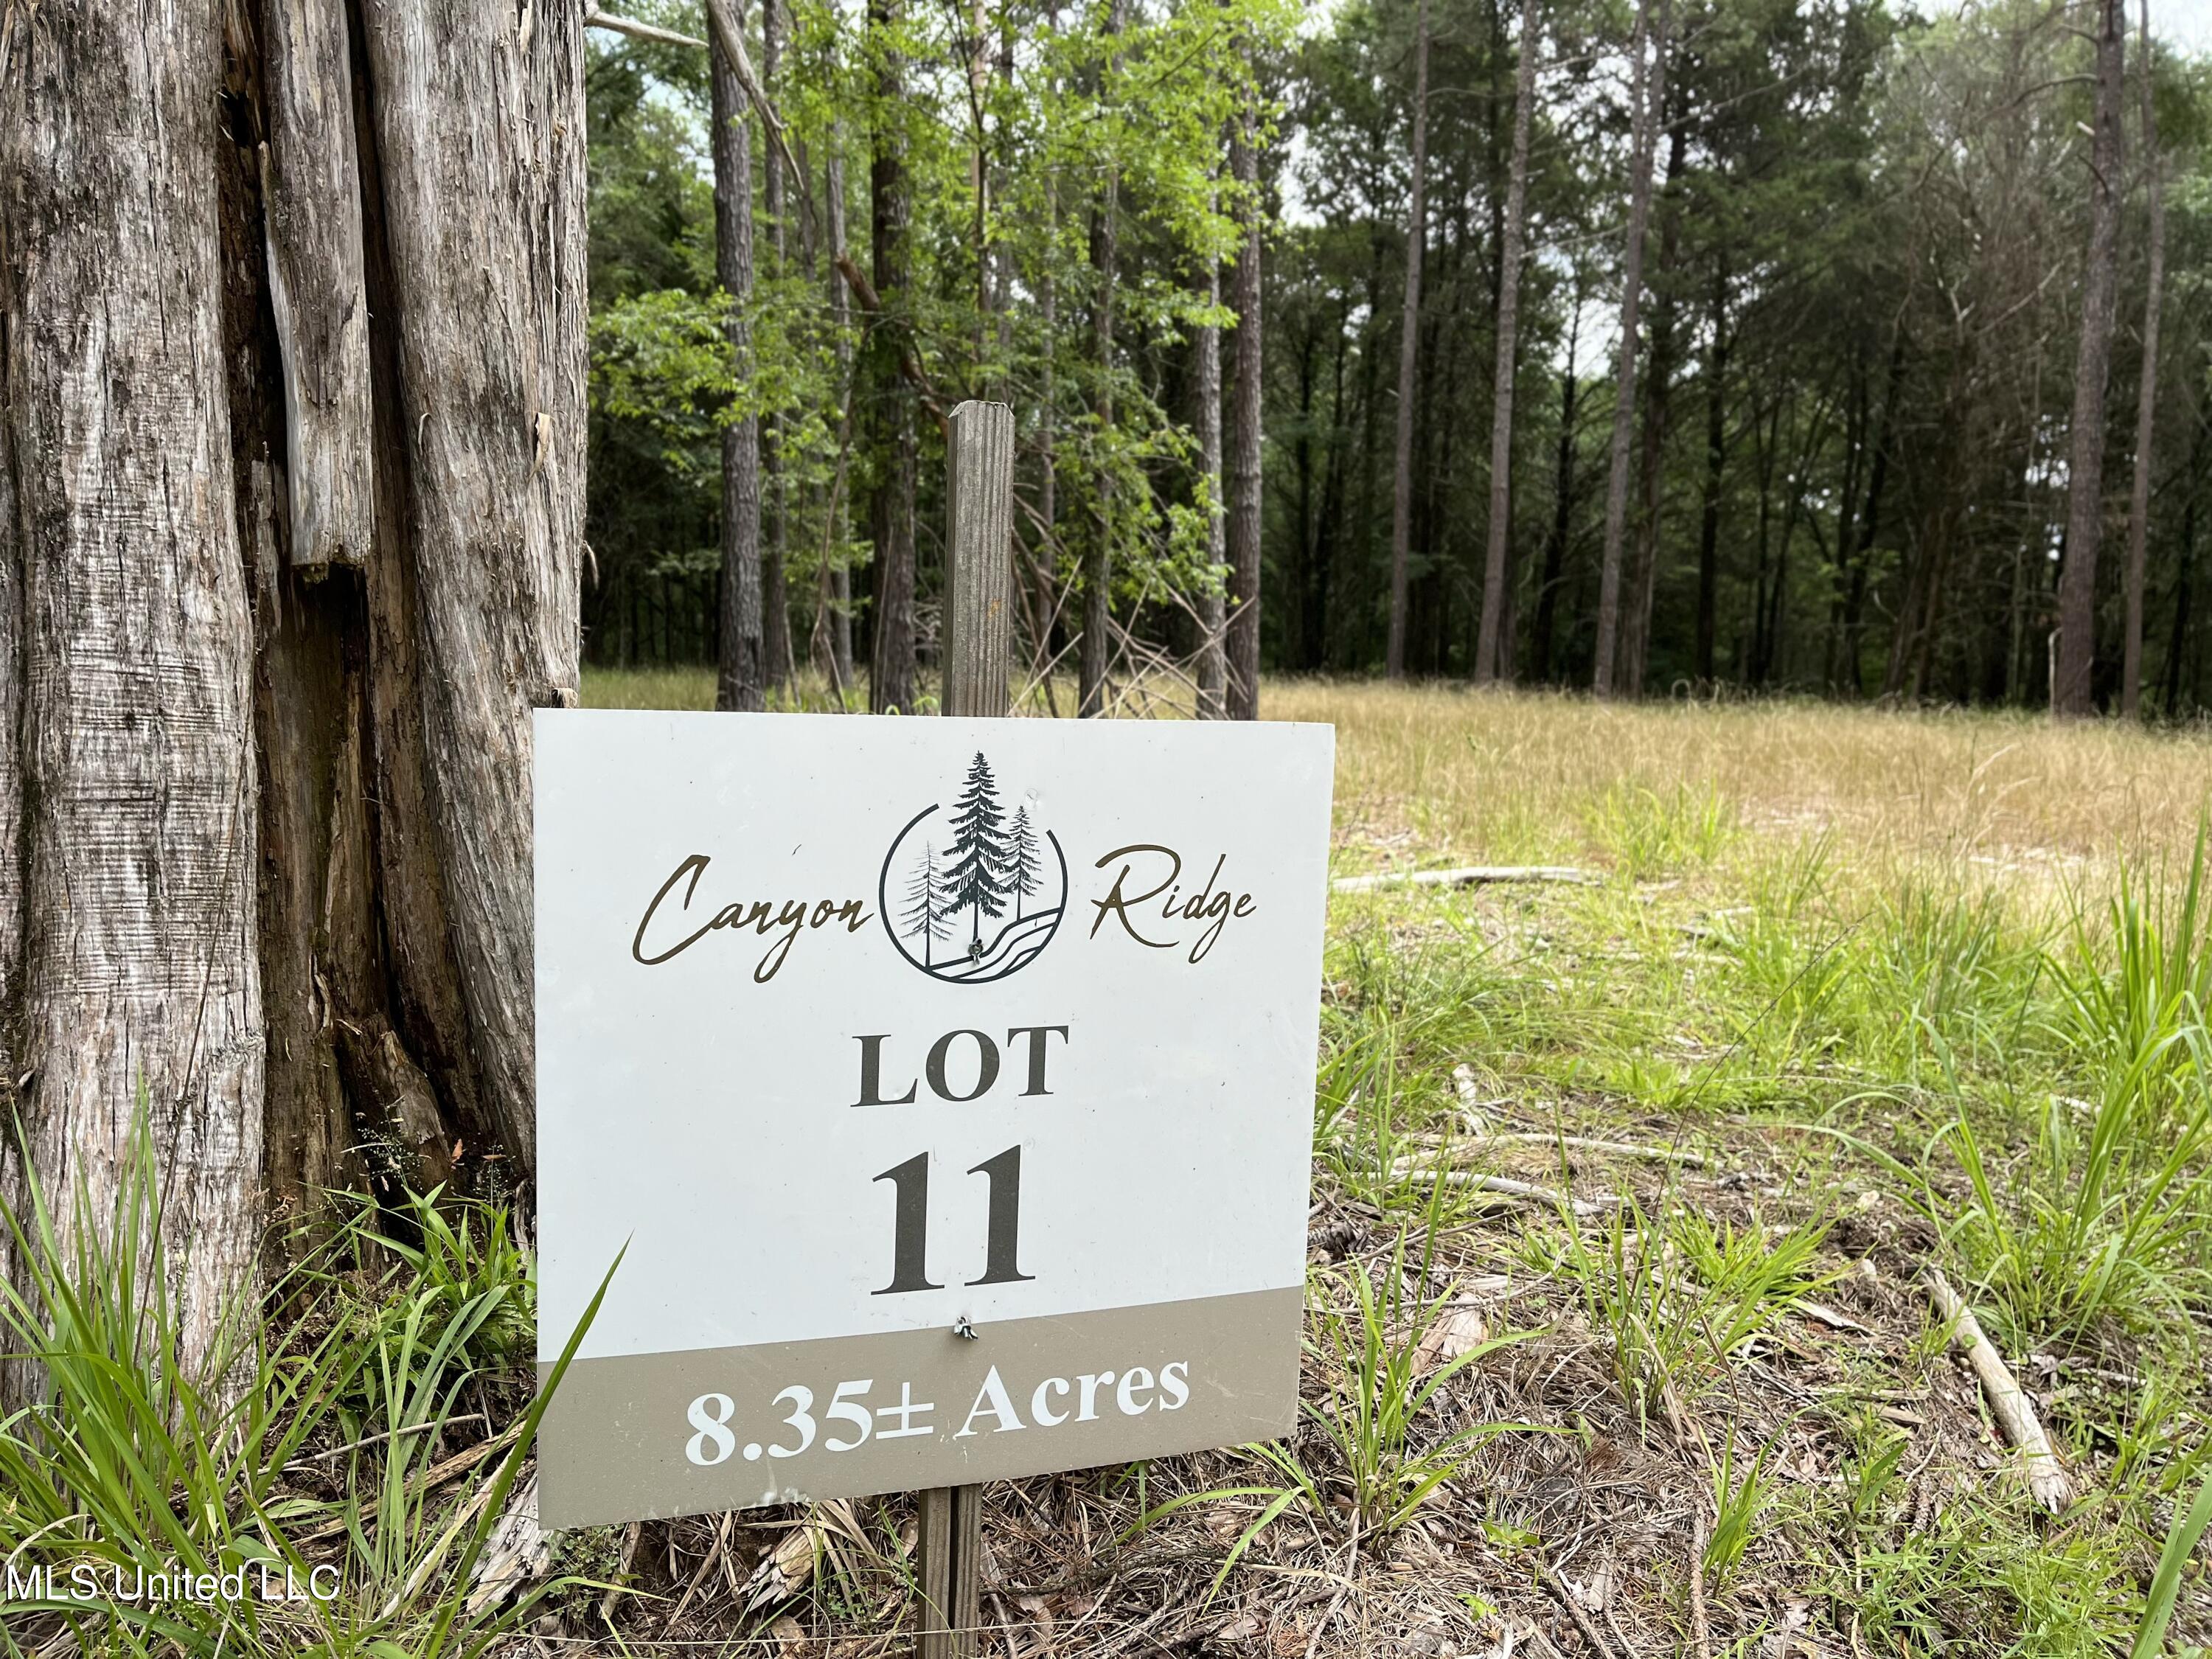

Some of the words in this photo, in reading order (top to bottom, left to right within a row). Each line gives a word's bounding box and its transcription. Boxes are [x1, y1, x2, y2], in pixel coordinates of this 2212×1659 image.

[632, 853, 875, 984] Canyon
[1089, 844, 1257, 964] Ridge
[849, 1024, 1069, 1108] LOT
[870, 1144, 1036, 1296] 11
[685, 1378, 935, 1466] 8.35±
[952, 1360, 1190, 1442] Acres
